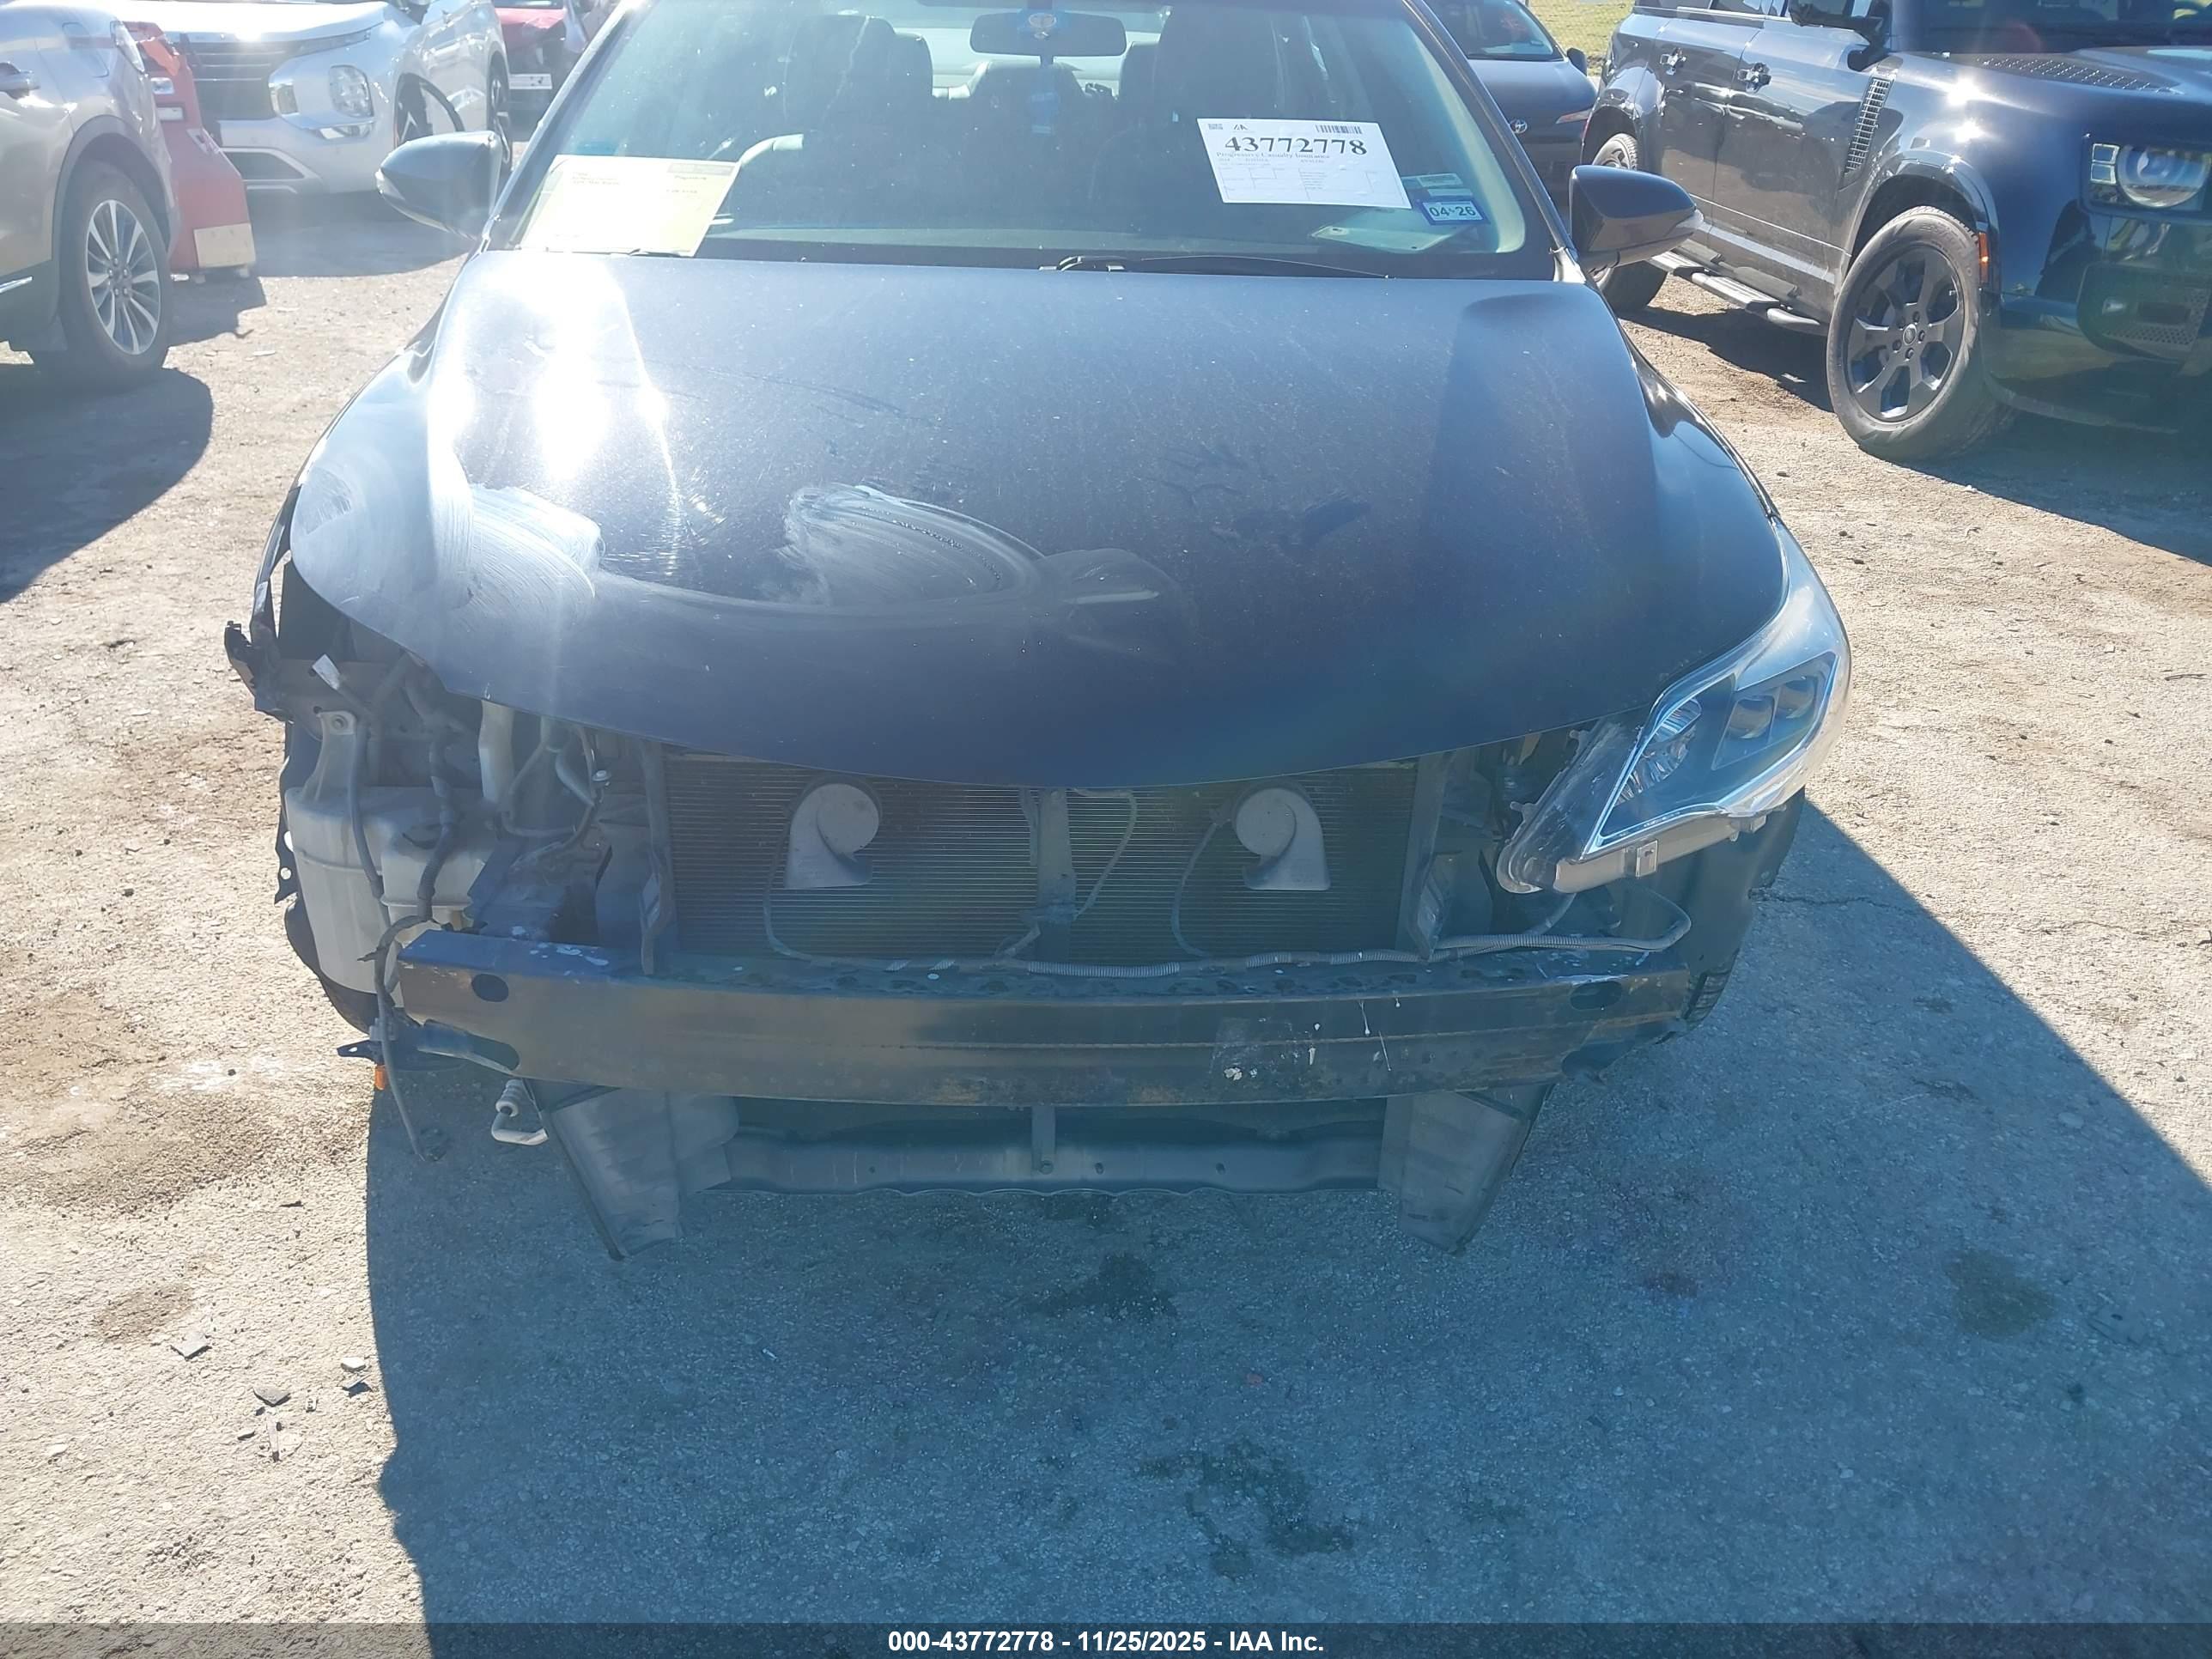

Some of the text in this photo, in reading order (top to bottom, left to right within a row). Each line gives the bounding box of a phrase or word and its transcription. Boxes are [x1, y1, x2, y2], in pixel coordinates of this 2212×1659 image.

[1224, 137, 1367, 155] 43772778
[1429, 206, 1476, 216] 04 26
